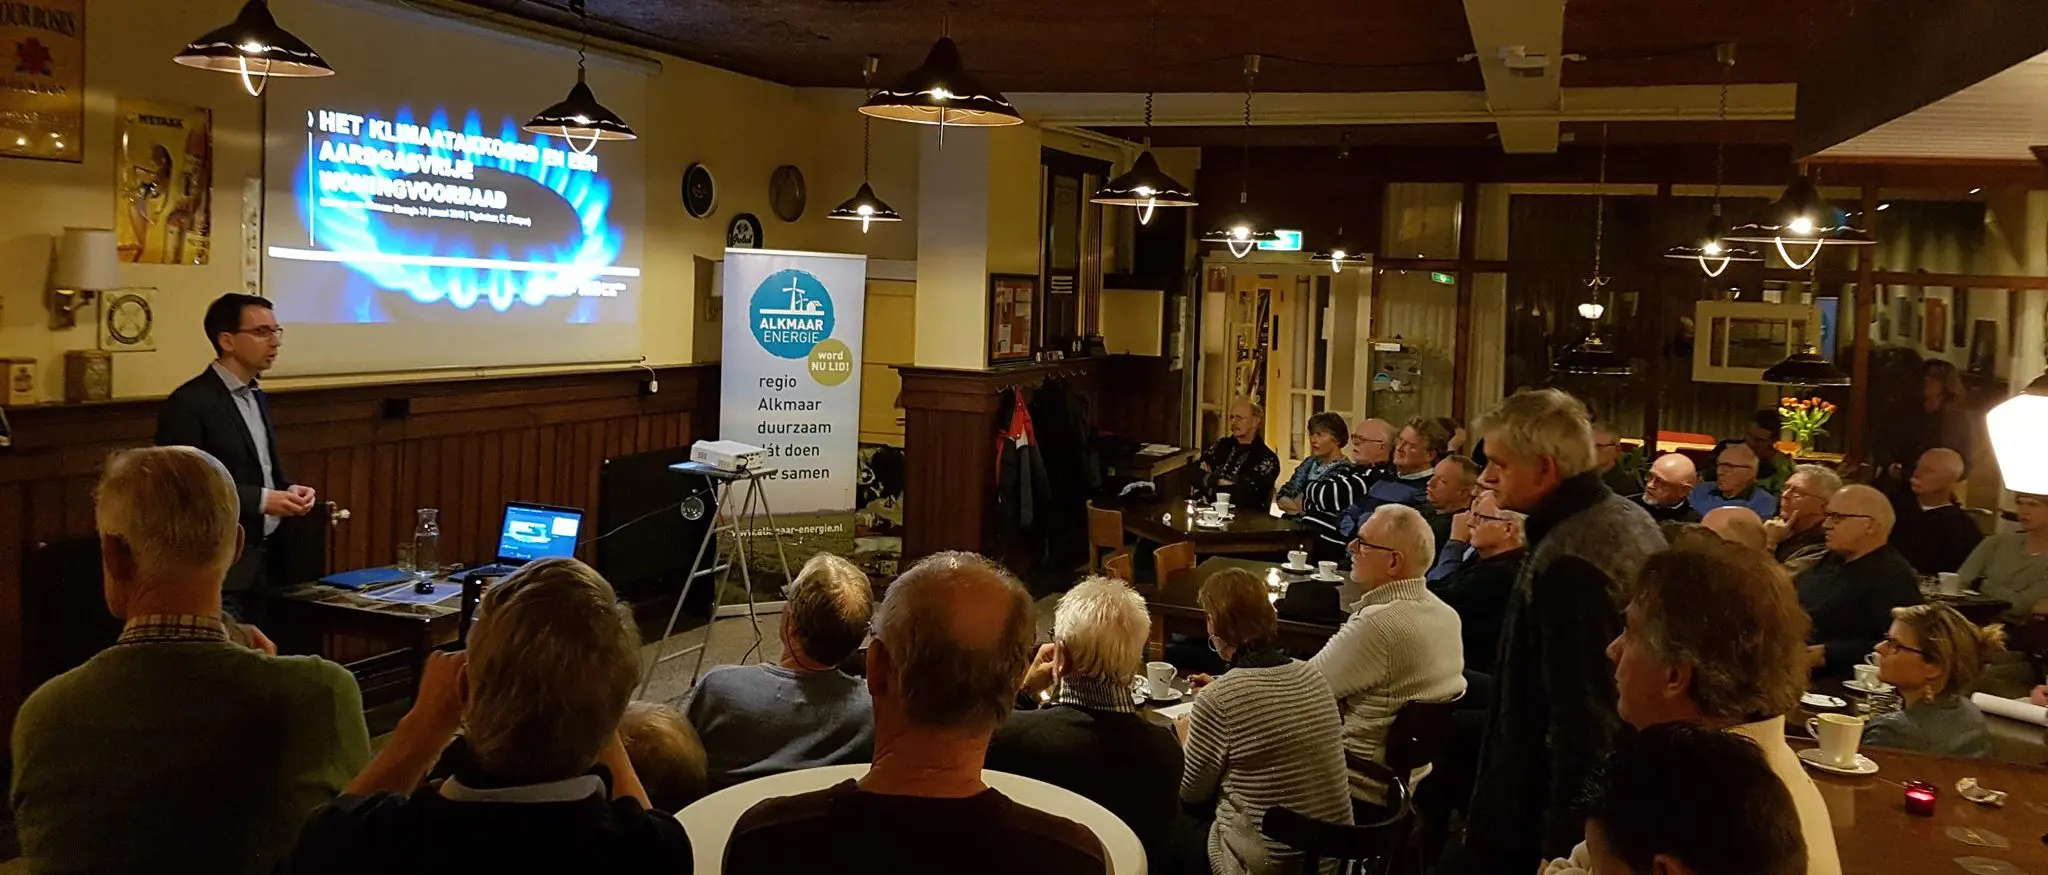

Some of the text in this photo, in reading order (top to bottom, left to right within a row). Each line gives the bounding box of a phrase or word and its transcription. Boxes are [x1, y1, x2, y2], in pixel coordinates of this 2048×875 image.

[319, 109, 364, 136] HET
[368, 118, 539, 163] KLIMAATAKKOORD
[542, 147, 565, 168] EN
[319, 140, 474, 180] AARDGASVRIJE
[319, 169, 508, 209] WONINGVOORRAAD
[760, 317, 824, 331] ALKMAAR
[763, 330, 820, 343] ENERGIE
[817, 351, 844, 360] word
[811, 361, 849, 371] NU LID!
[759, 374, 797, 391] regio
[757, 397, 822, 411] Alkmaar
[757, 420, 832, 434] duurzaam
[762, 443, 820, 457] át doen
[781, 468, 830, 480] samen
